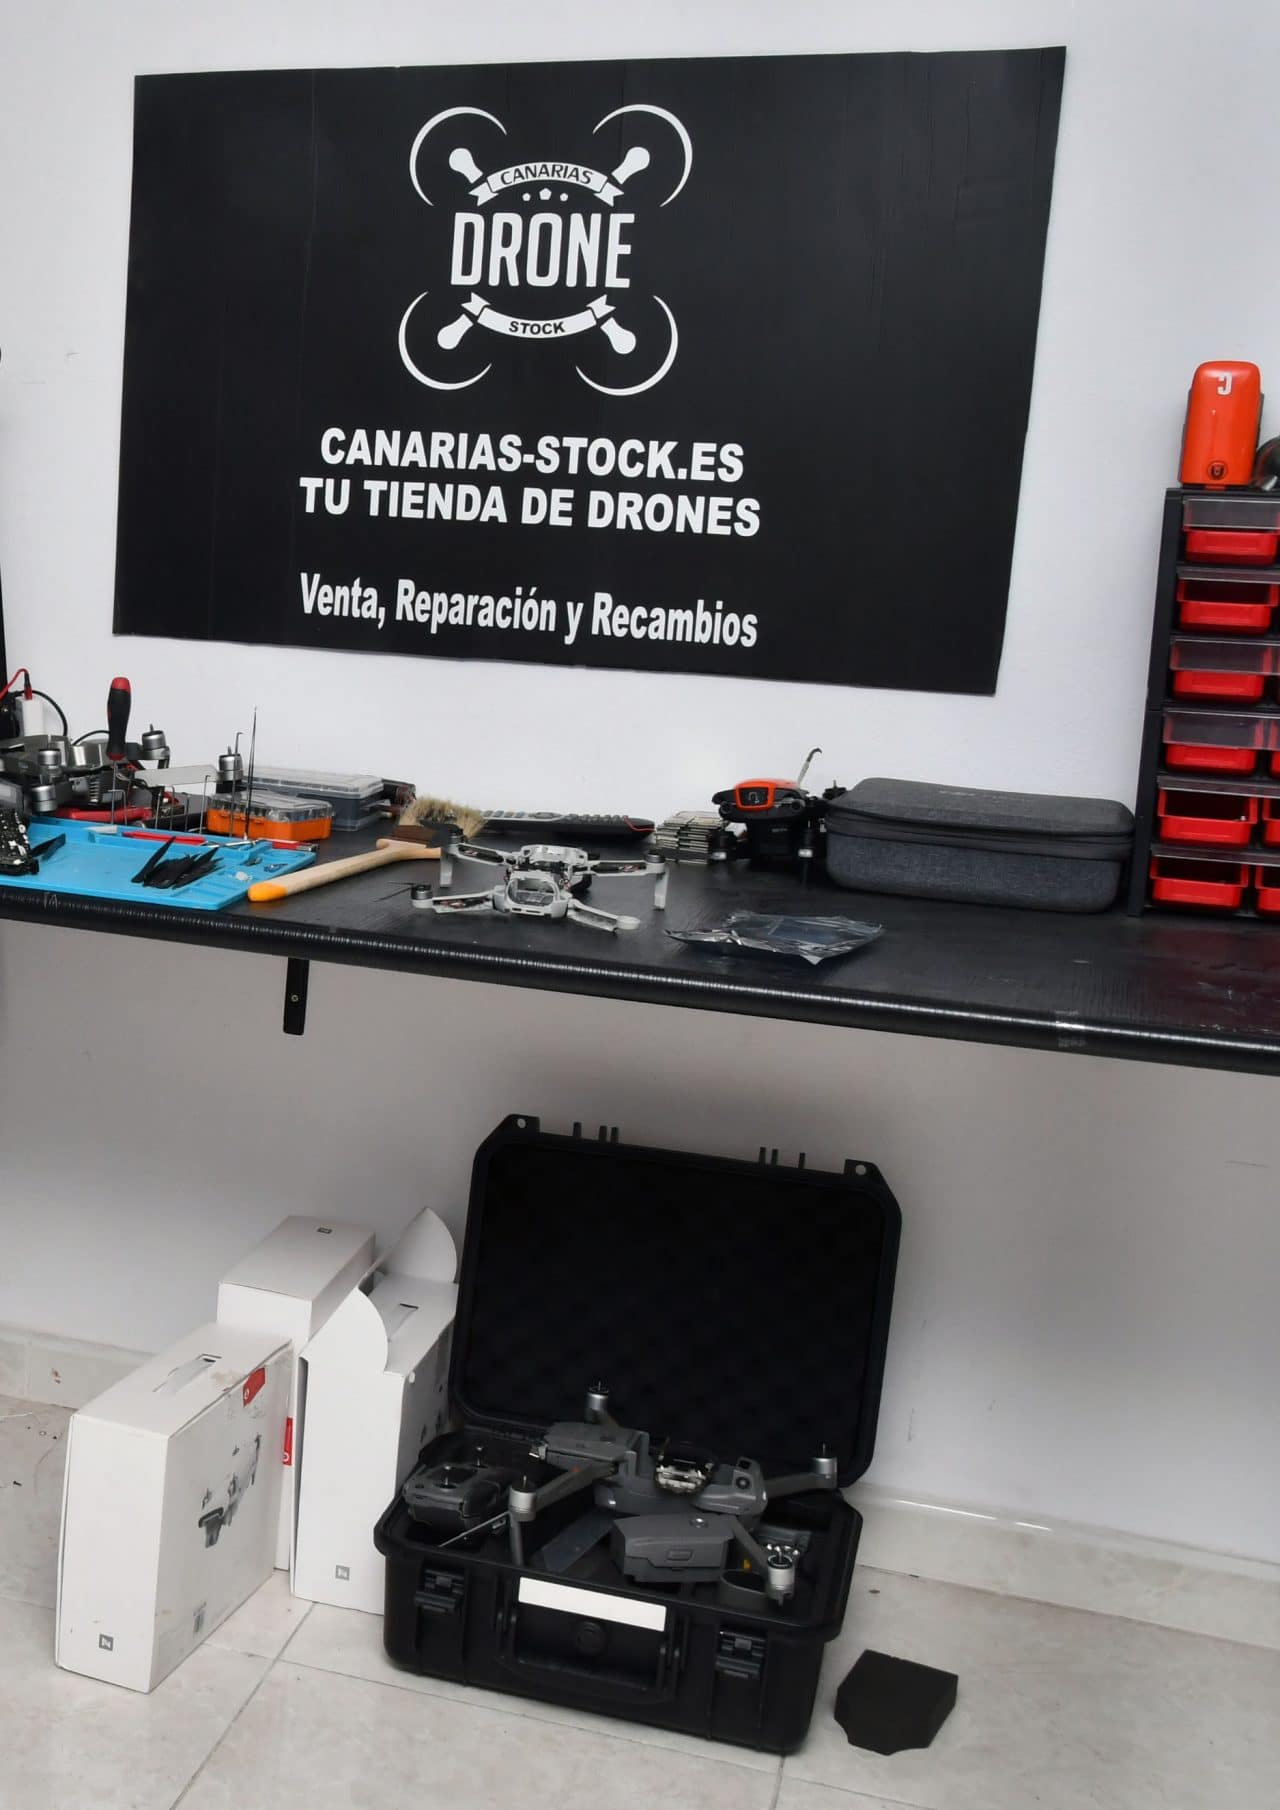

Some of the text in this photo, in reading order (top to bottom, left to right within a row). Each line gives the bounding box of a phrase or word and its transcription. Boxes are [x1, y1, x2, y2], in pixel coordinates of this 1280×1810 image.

[499, 163, 594, 186] CANARIAS
[450, 211, 636, 289] DRONE
[508, 320, 566, 336] STOCK
[320, 427, 744, 483] CANARIAS-STOCK.ES
[299, 476, 761, 537] TU TIENDA DE DRONES
[300, 572, 758, 648] Venta, Reparación y Recambios
